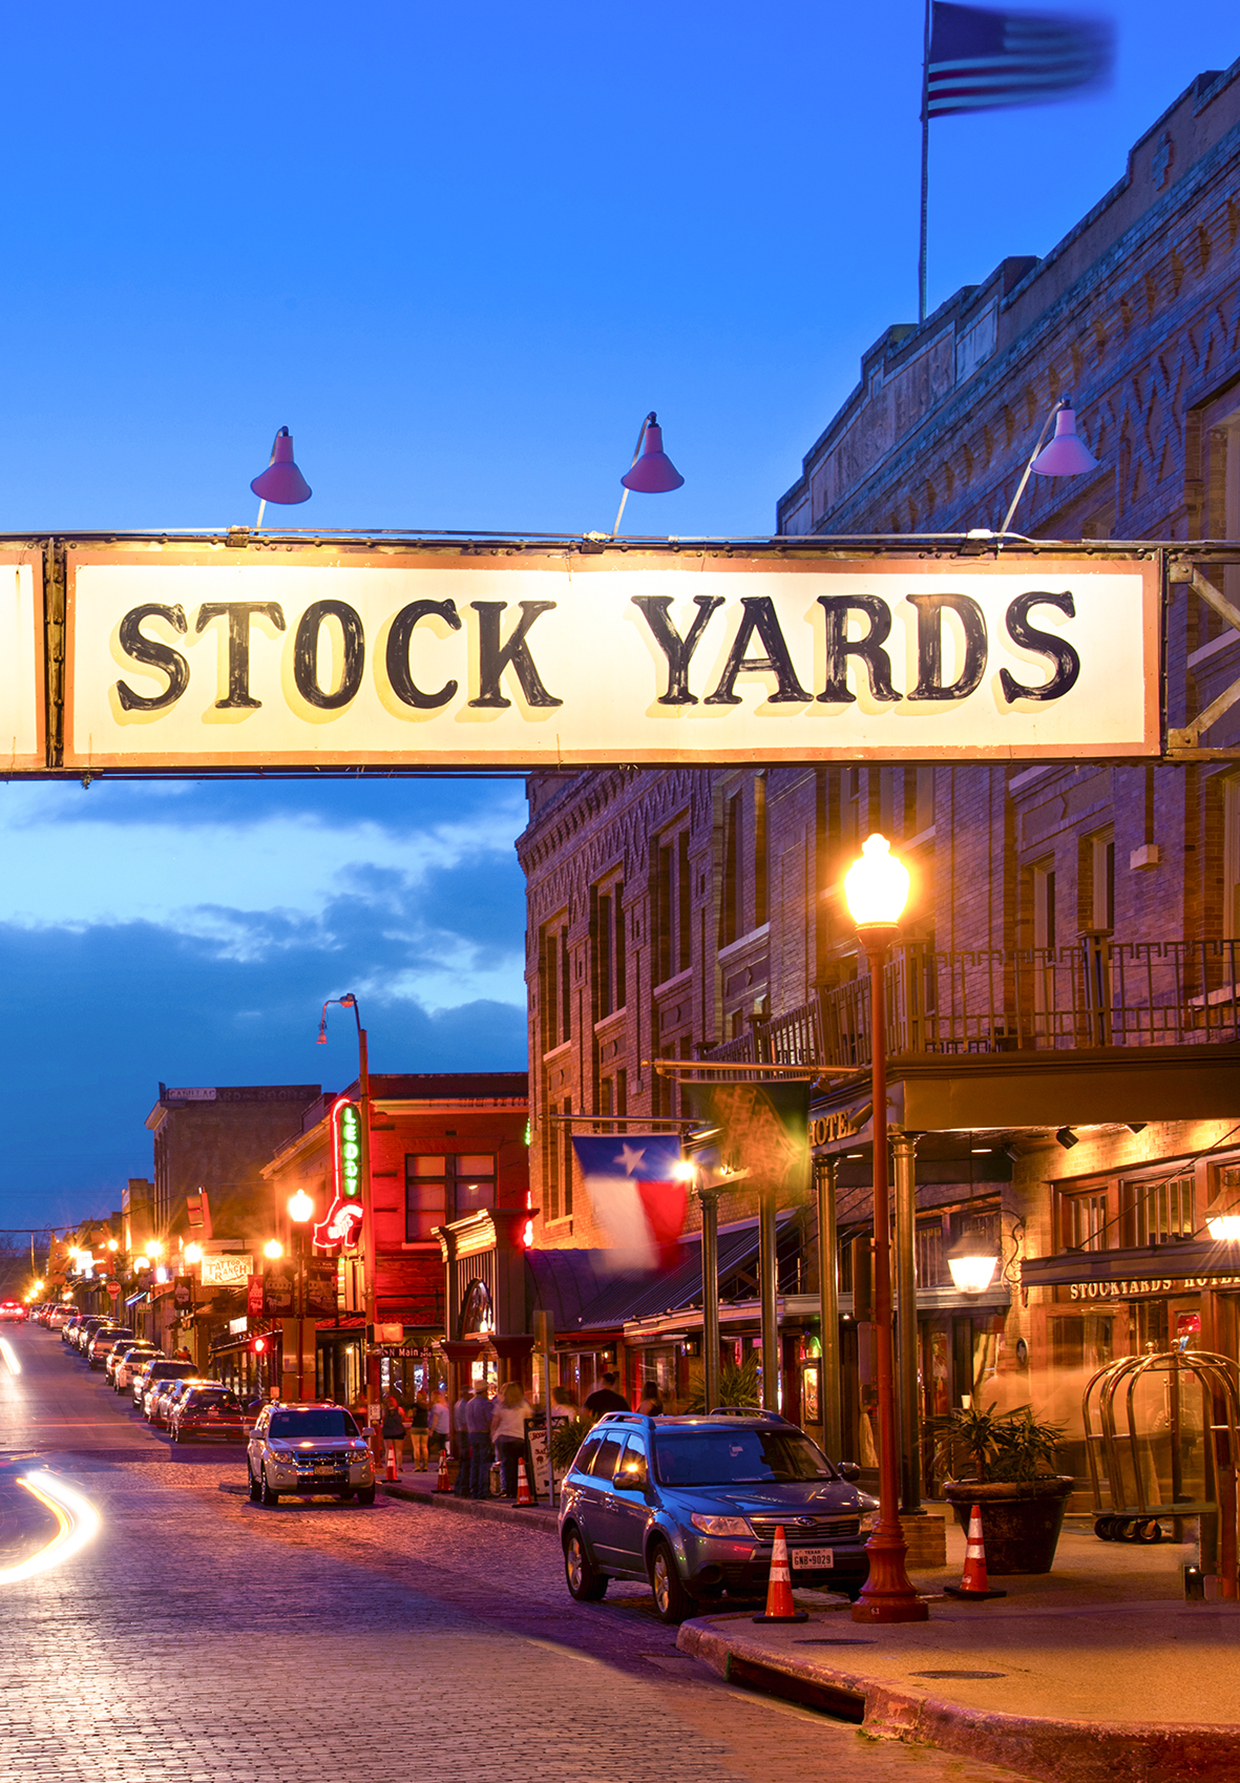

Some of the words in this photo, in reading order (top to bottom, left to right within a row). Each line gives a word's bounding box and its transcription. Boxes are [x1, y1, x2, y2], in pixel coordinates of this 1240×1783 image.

[115, 598, 563, 711] STOCK
[630, 590, 1080, 706] YARDS
[170, 1089, 217, 1099] CADILLAC
[344, 1107, 358, 1196] LEDDY
[206, 1260, 240, 1275] TATTOO
[215, 1265, 247, 1281] RANCH
[1070, 1279, 1173, 1300] STOCKYARDS
[389, 1348, 395, 1357] N
[399, 1347, 419, 1357] Main
